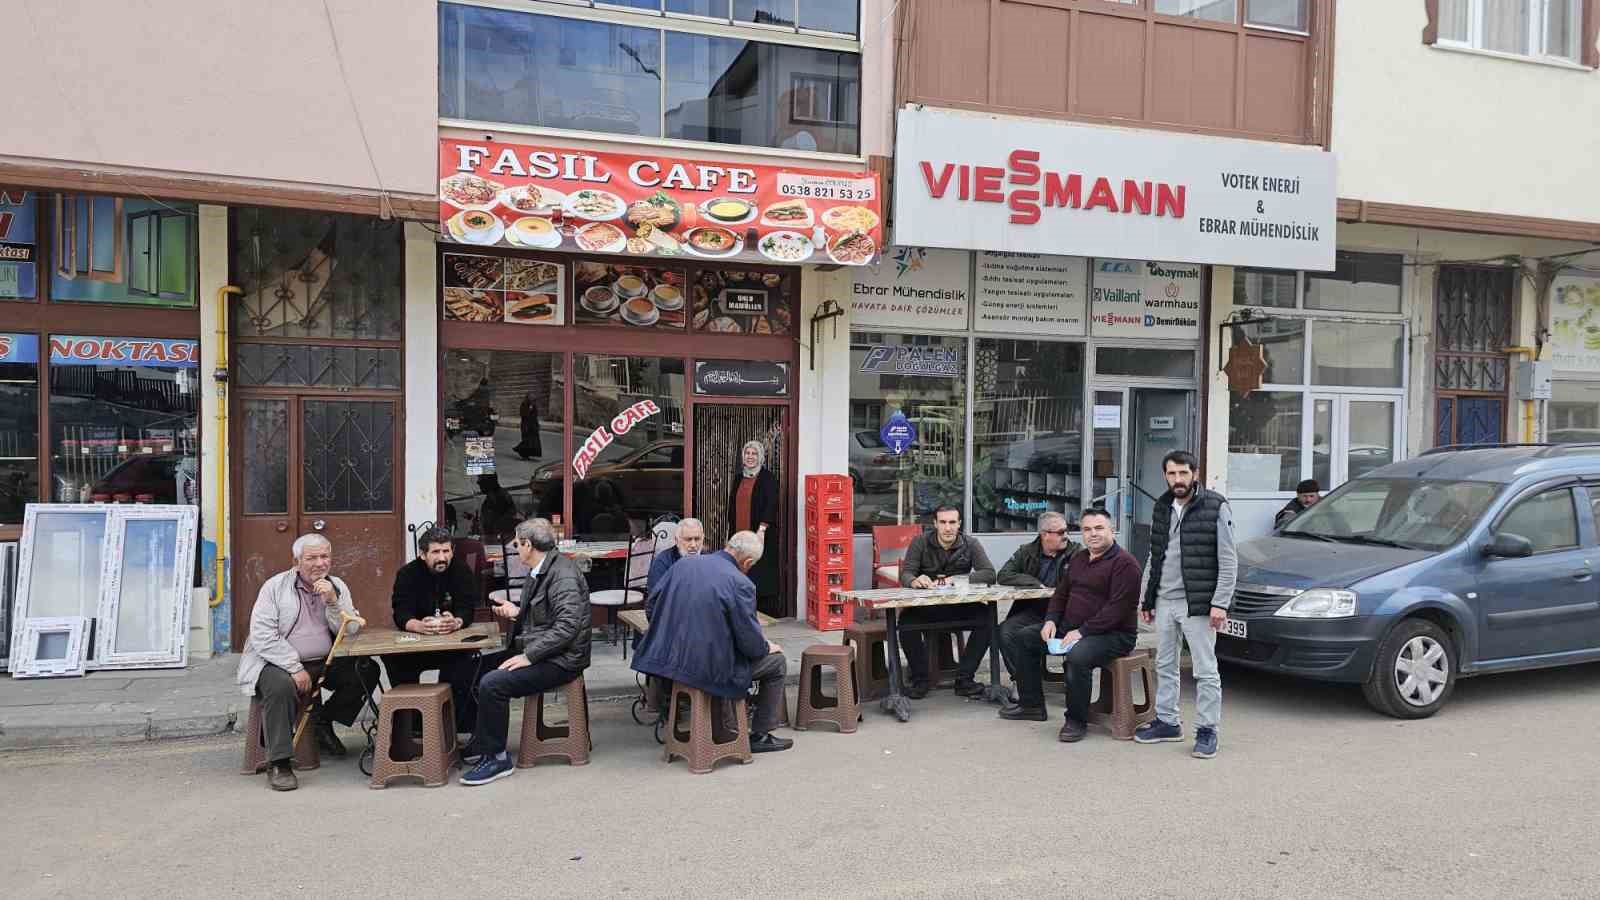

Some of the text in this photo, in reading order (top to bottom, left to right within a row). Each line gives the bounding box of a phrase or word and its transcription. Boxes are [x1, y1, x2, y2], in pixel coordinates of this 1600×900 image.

[456, 145, 758, 193] FASIL CAFE
[782, 184, 871, 200] 0538 821 53 25
[919, 149, 1186, 225] VIESSMANN
[1221, 173, 1300, 194] VOTEK ENERJİ
[1257, 199, 1265, 214] &
[1199, 217, 1319, 241] EBRAR MÜHENDİSLİK
[854, 283, 966, 301] Ebrar Mühendislik
[1103, 288, 1141, 302] Vaillant
[1145, 300, 1199, 310] warmhaus
[573, 400, 660, 480] FASIL CAFE
[1227, 620, 1245, 636] 399
